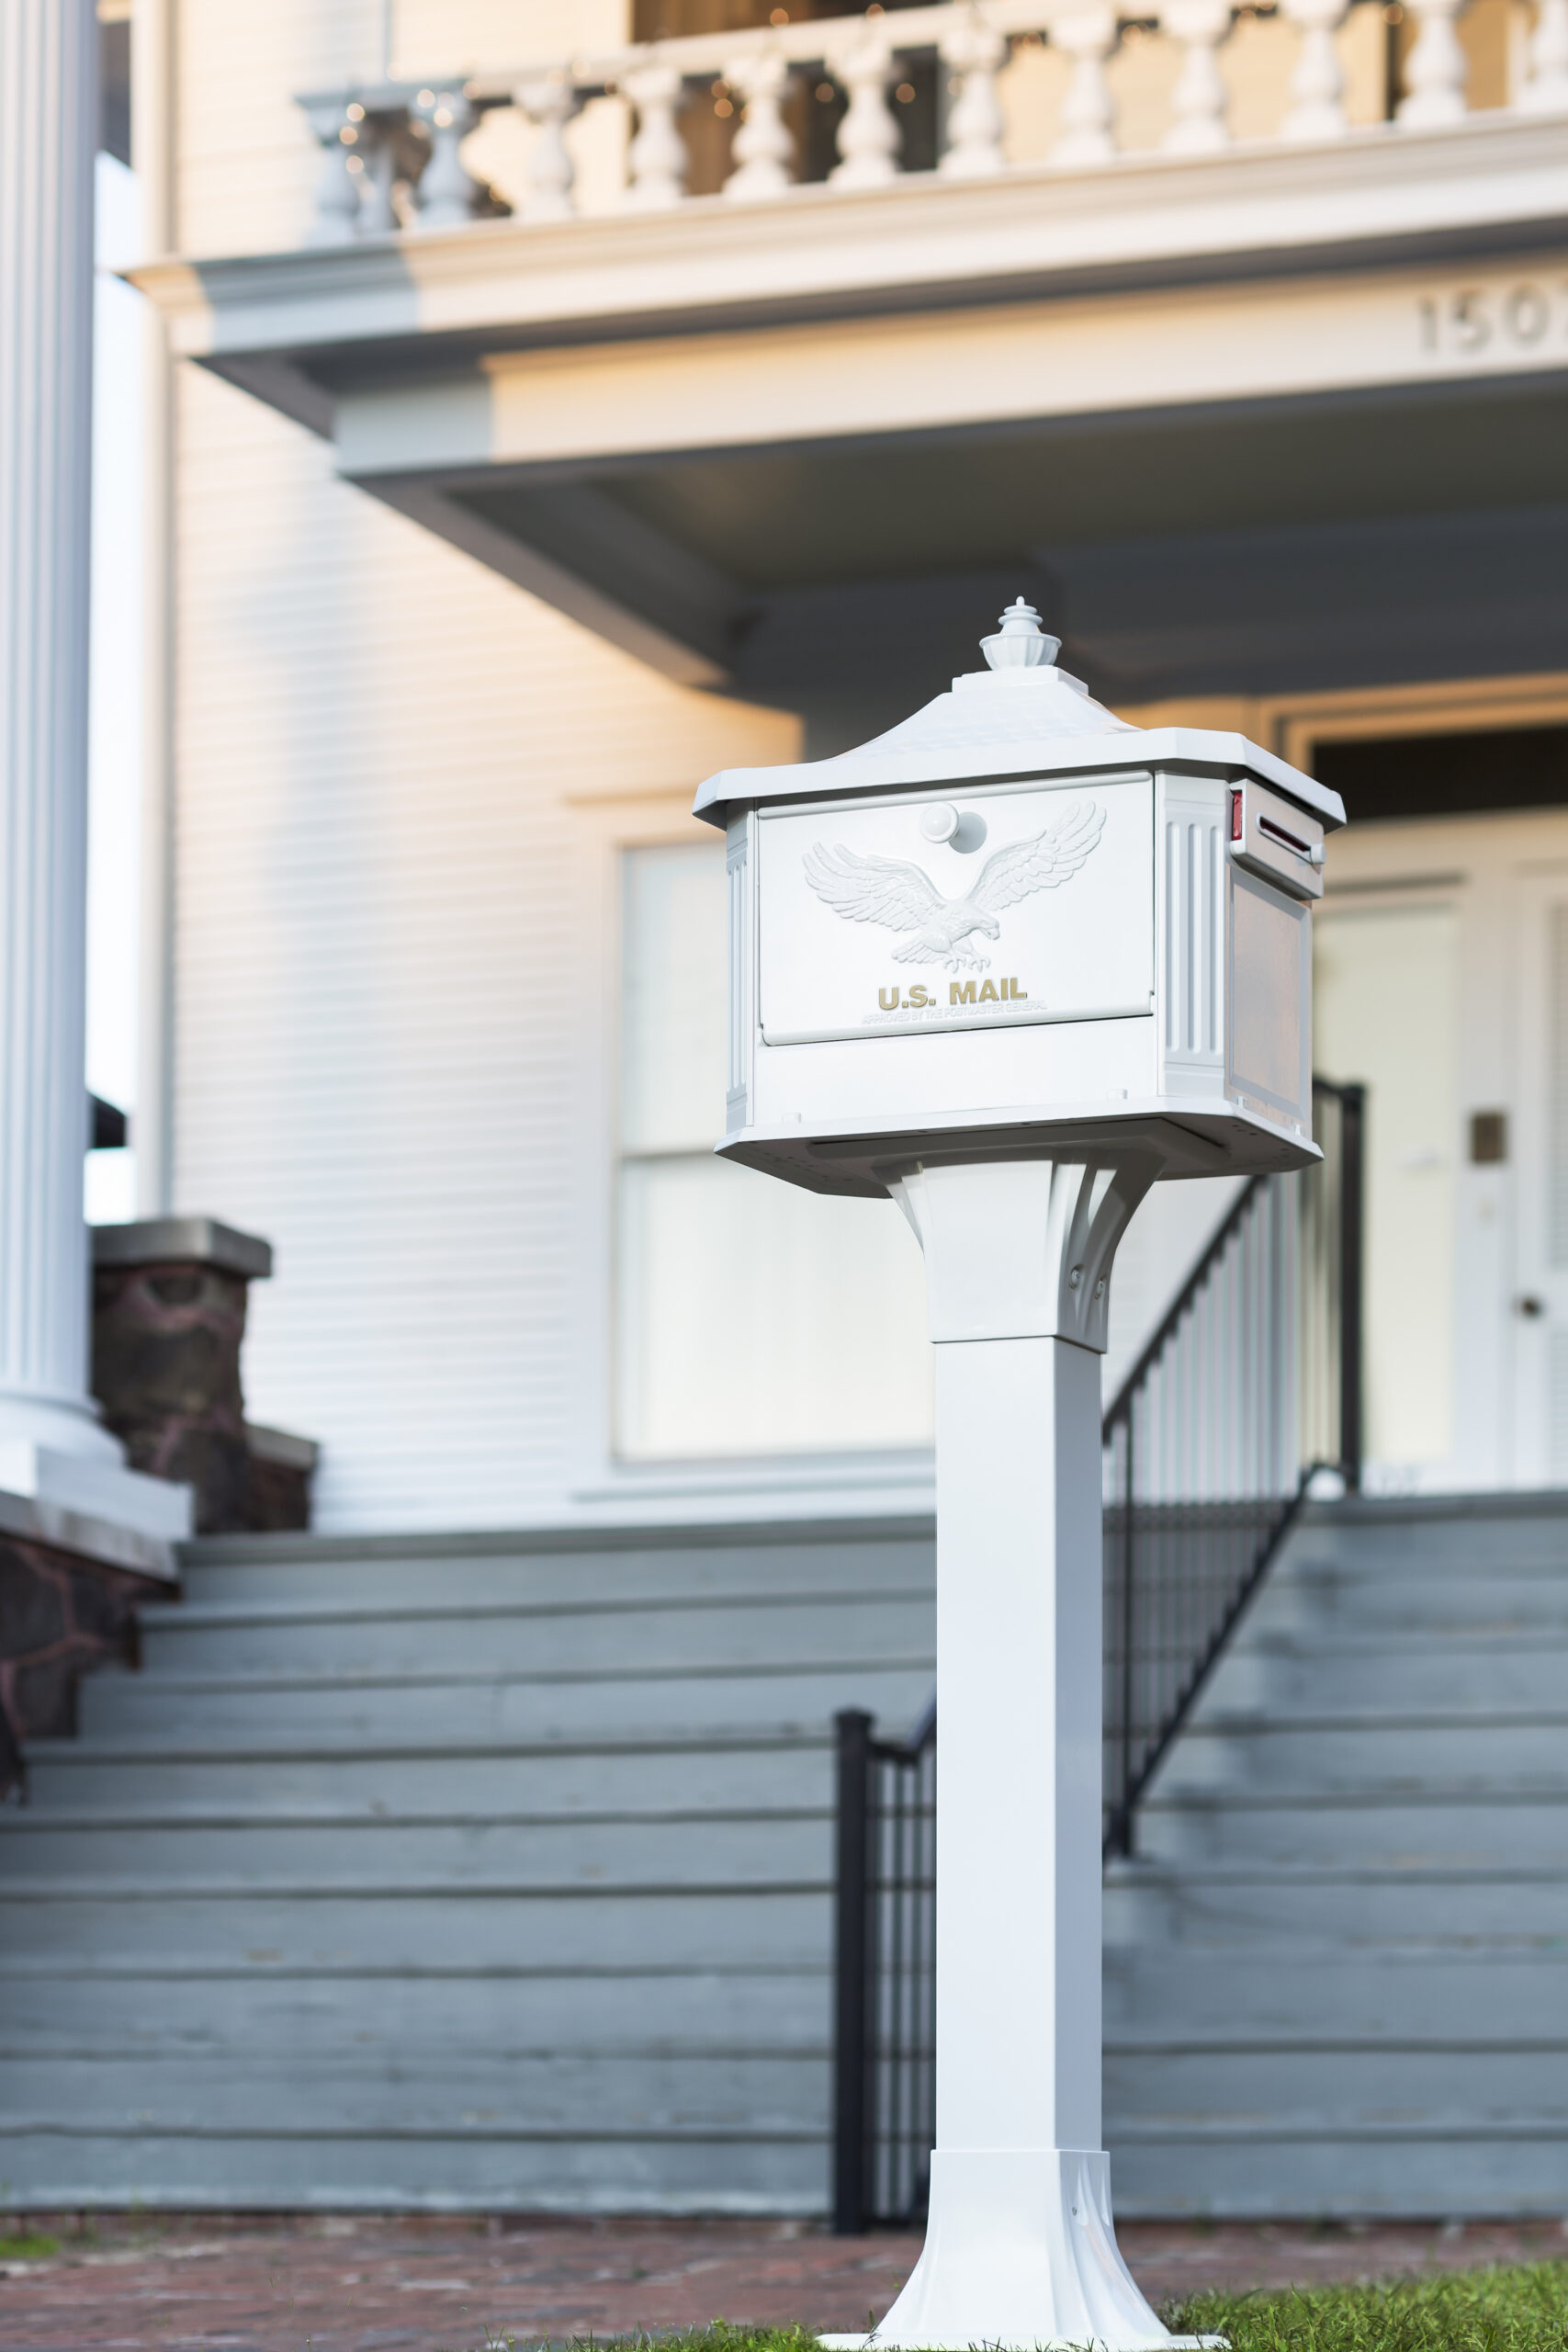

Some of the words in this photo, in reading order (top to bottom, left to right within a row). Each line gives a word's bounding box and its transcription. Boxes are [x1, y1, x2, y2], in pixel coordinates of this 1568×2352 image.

[1416, 278, 1568, 358] 150
[878, 985, 936, 1011] U.S.
[949, 977, 1028, 1005] MAIL
[862, 1011, 910, 1024] APPROVED
[911, 1009, 925, 1022] BY
[925, 1007, 943, 1020] THE
[944, 1002, 1005, 1019] POSTMASTER
[1006, 999, 1047, 1013] GENERAL
